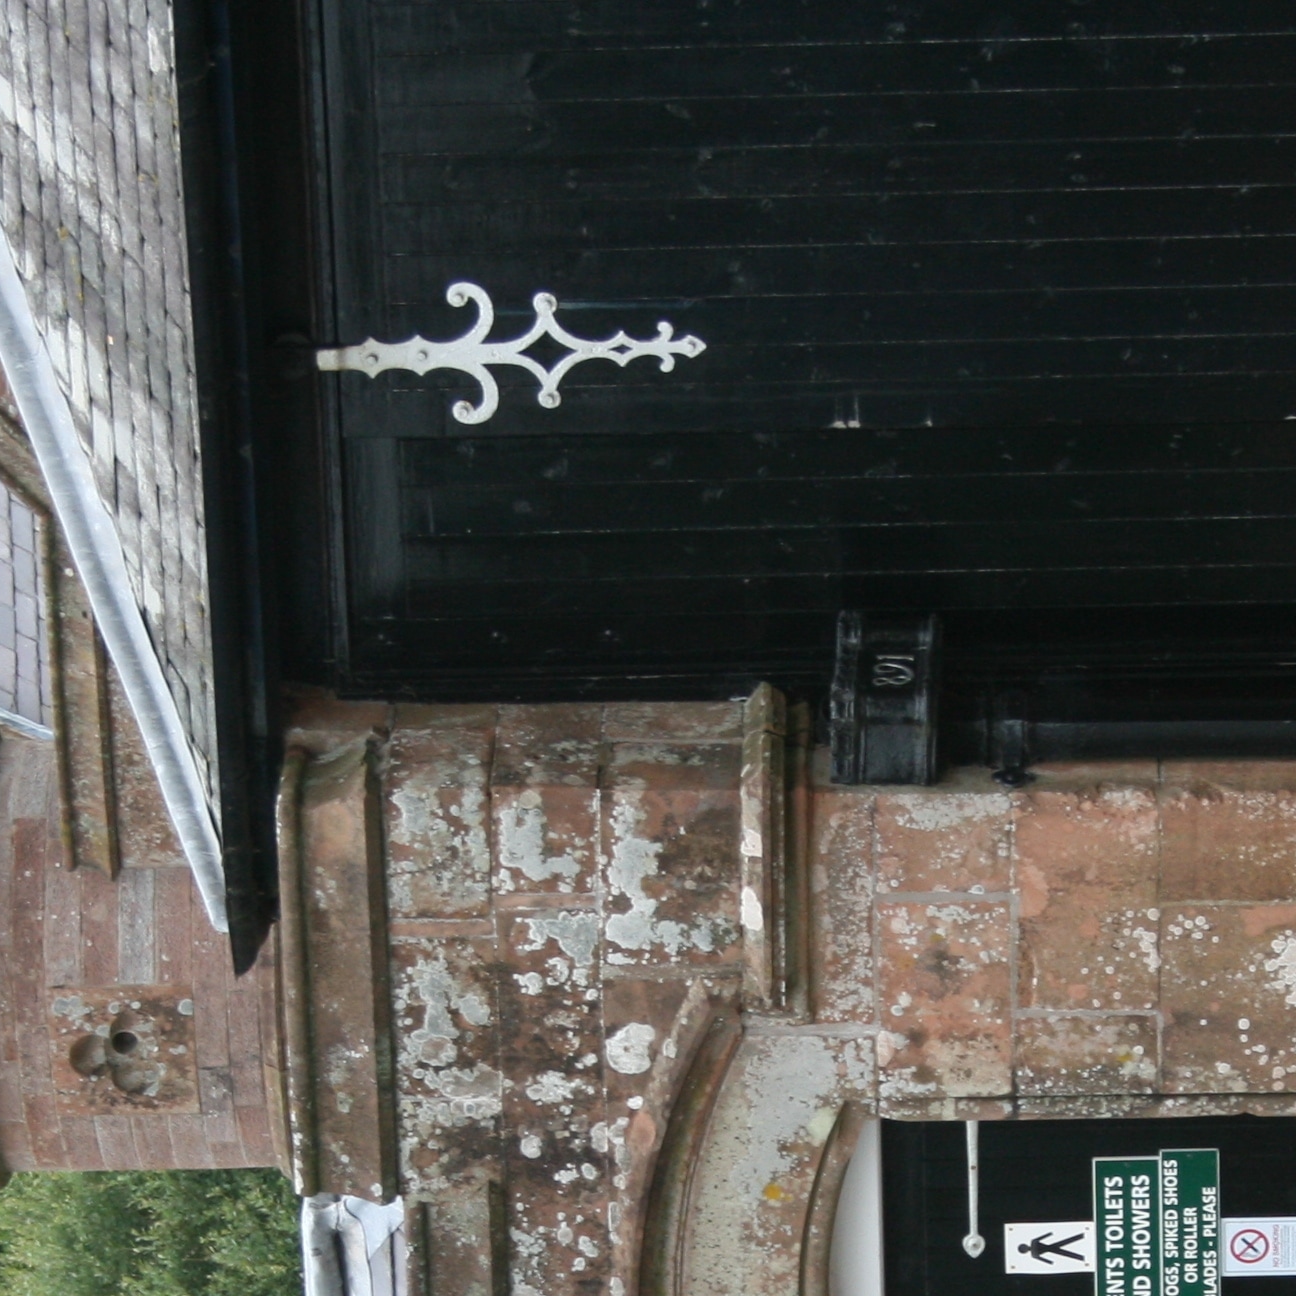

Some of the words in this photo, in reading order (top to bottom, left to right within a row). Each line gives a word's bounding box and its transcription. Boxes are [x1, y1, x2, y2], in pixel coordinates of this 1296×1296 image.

[1163, 1159, 1178, 1206] SHOES
[1104, 1176, 1124, 1252] TOILETS
[1131, 1174, 1151, 1270] SHOWERS
[1164, 1209, 1179, 1258] SPIKED
[1183, 1207, 1198, 1259] ROLLER
[1202, 1186, 1217, 1237] PLEASE
[1272, 1224, 1280, 1256] SMOKING
[1272, 1257, 1280, 1268] NO
[1184, 1263, 1198, 1283] OR
